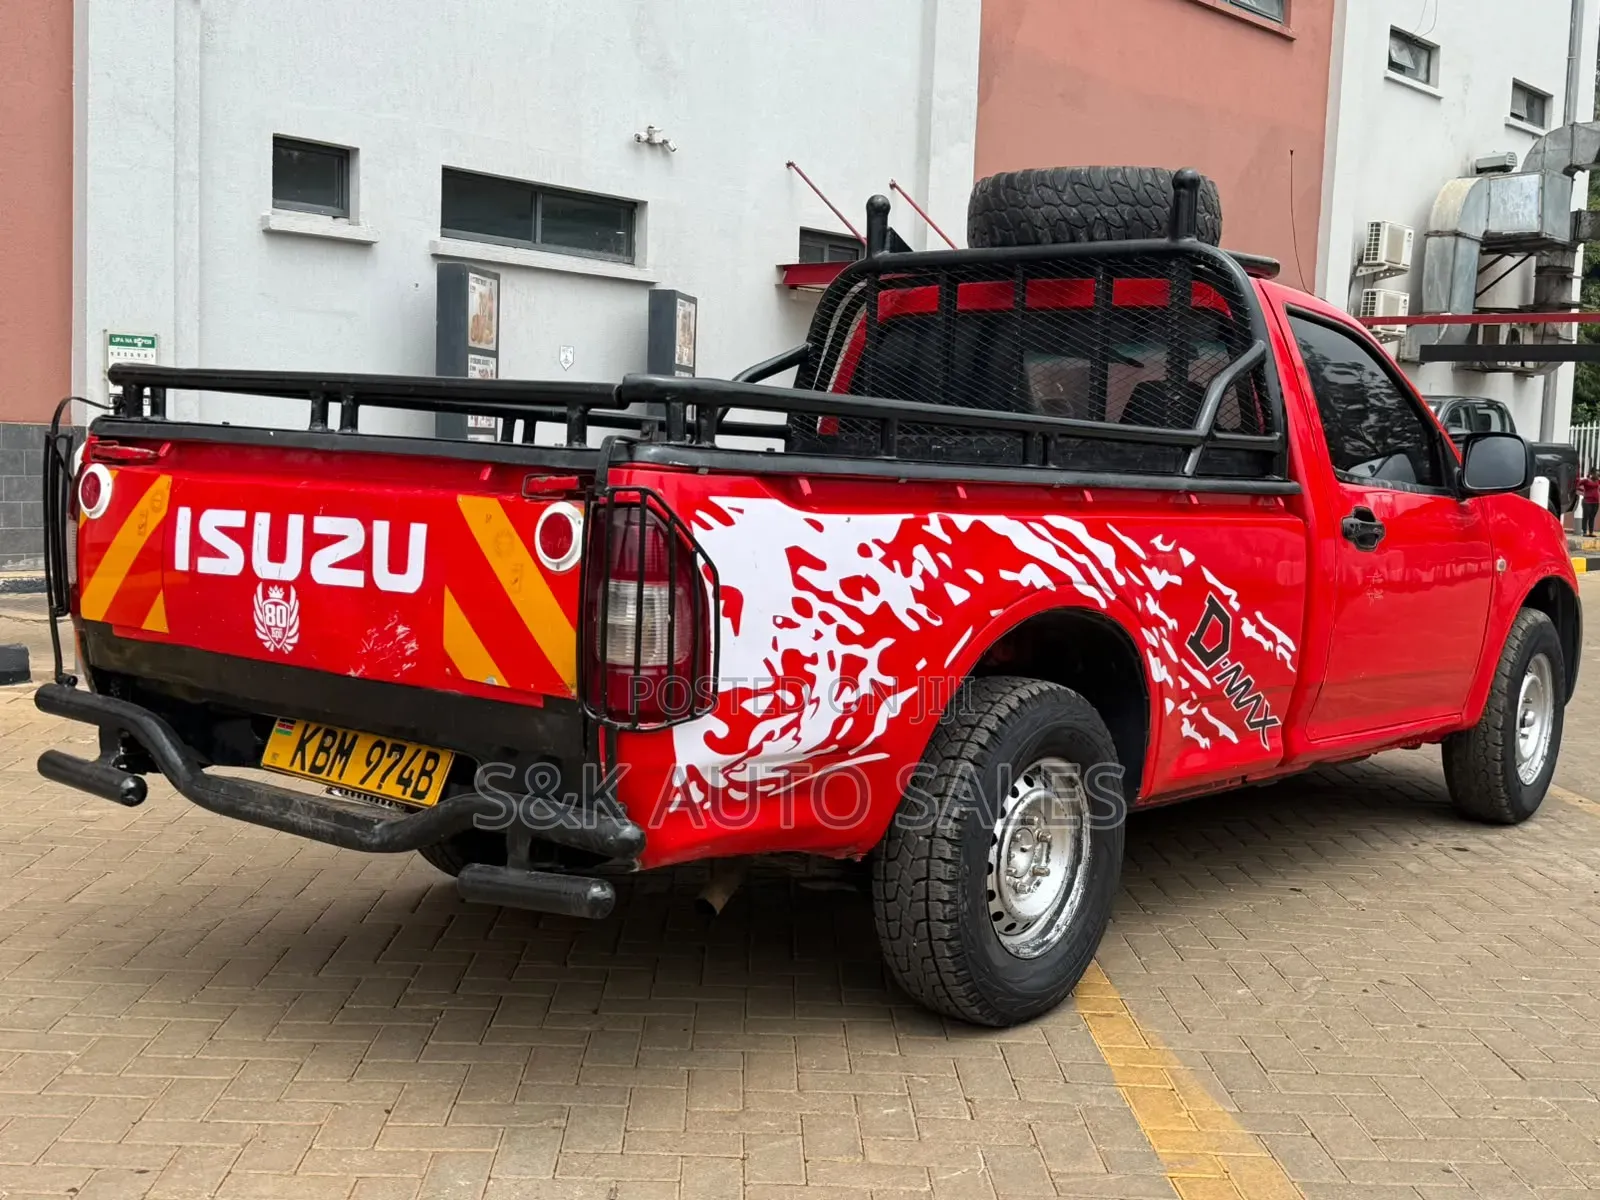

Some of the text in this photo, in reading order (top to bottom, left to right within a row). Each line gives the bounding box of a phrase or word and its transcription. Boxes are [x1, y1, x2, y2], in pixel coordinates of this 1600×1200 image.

[174, 506, 428, 594] ISUZU
[265, 604, 287, 627] 80
[289, 723, 440, 800] KBM 974B
